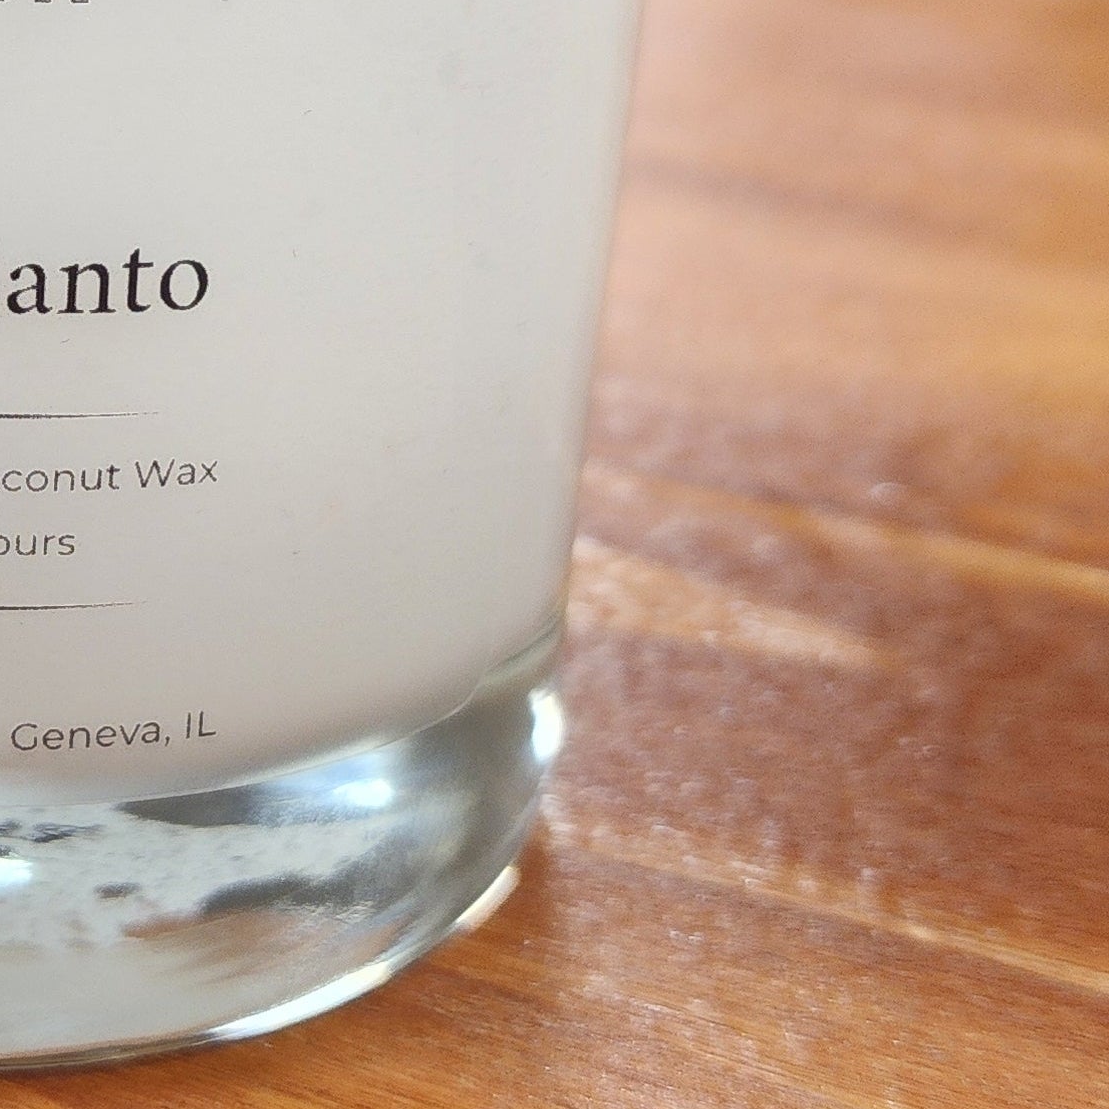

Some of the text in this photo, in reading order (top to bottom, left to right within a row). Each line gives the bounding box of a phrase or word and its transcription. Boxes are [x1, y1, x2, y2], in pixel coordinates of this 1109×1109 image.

[135, 459, 217, 488] Wax
[11, 722, 170, 751] Geneva,
[186, 711, 216, 739] IL
